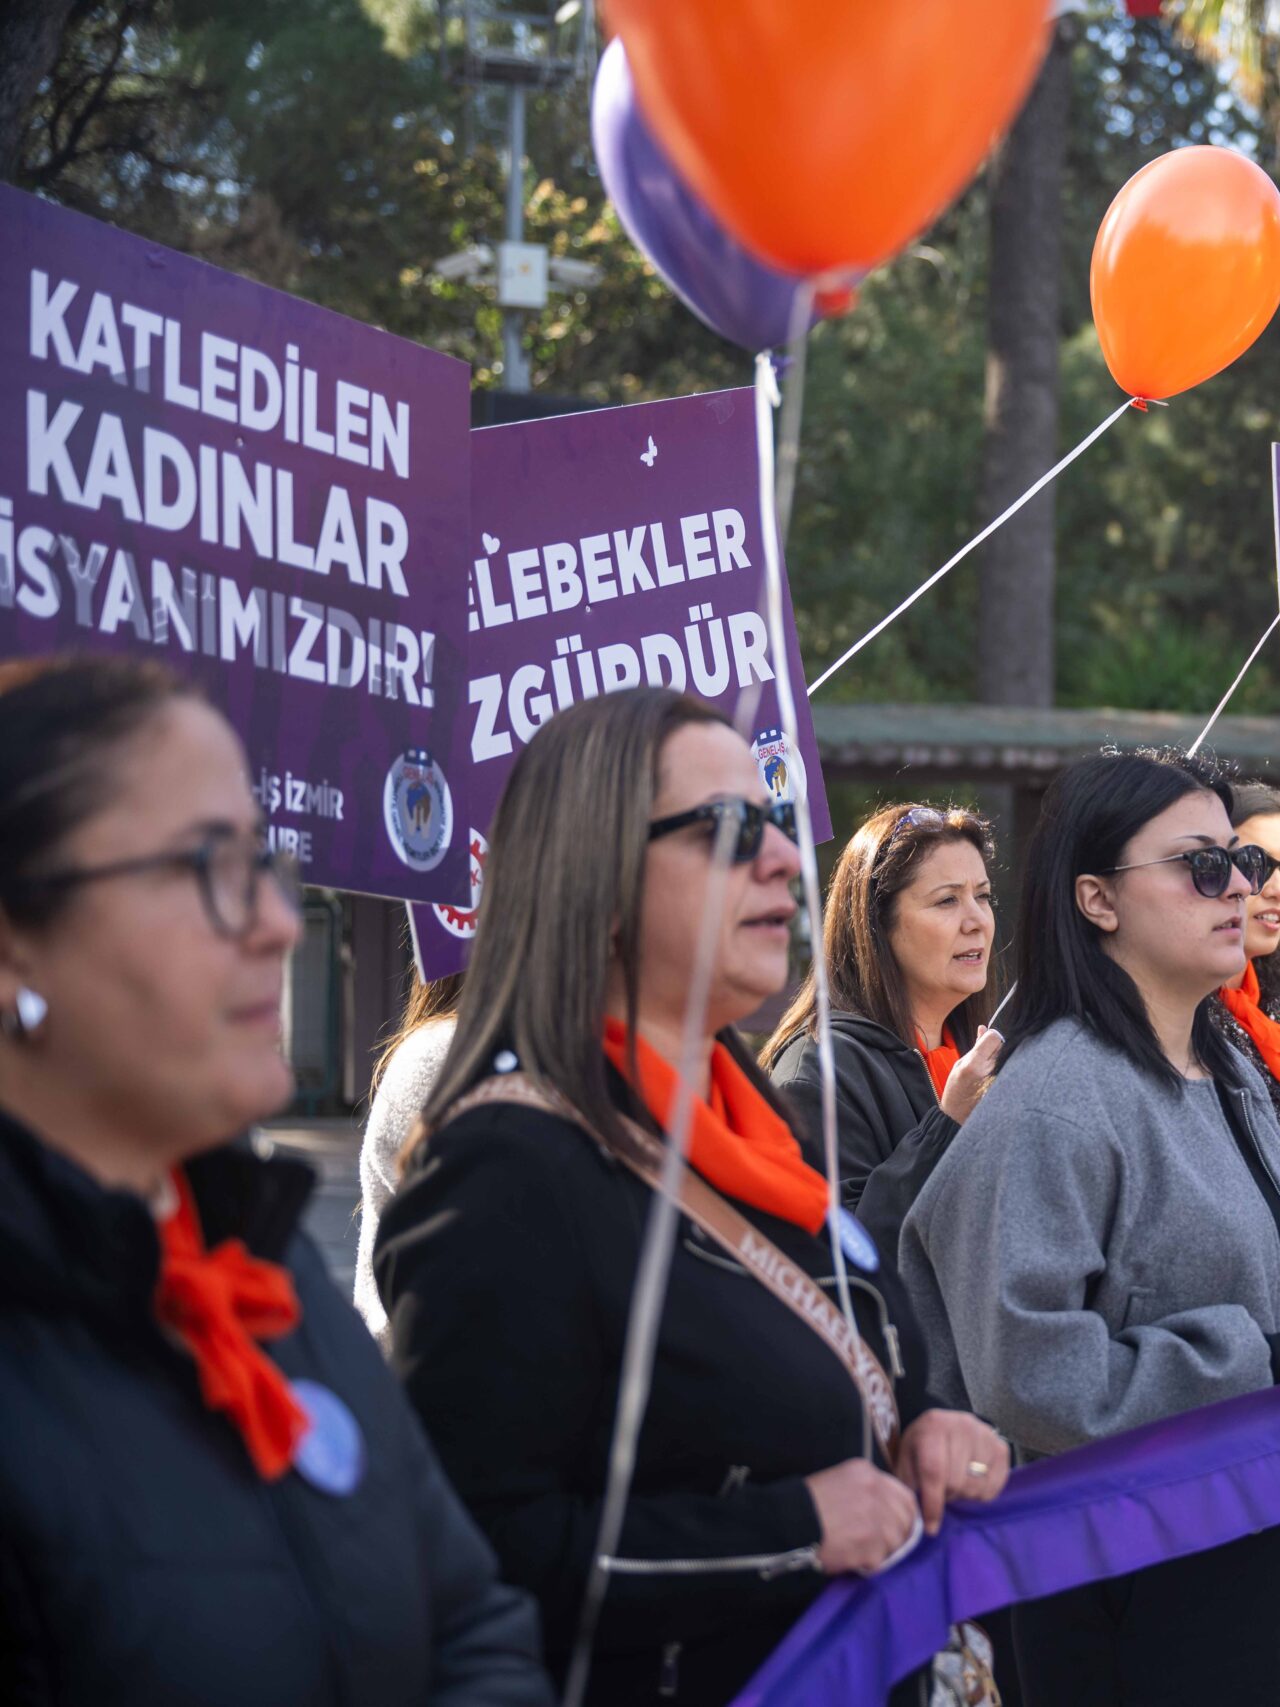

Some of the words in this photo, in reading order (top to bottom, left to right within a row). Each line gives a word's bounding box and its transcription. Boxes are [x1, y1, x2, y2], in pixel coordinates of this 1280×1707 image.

[29, 268, 410, 479] KATLEDİLEN
[27, 389, 409, 597] KADINLAR
[468, 508, 752, 632] LEBEKLER
[265, 825, 313, 862] UBE
[284, 770, 344, 820] İZMİR
